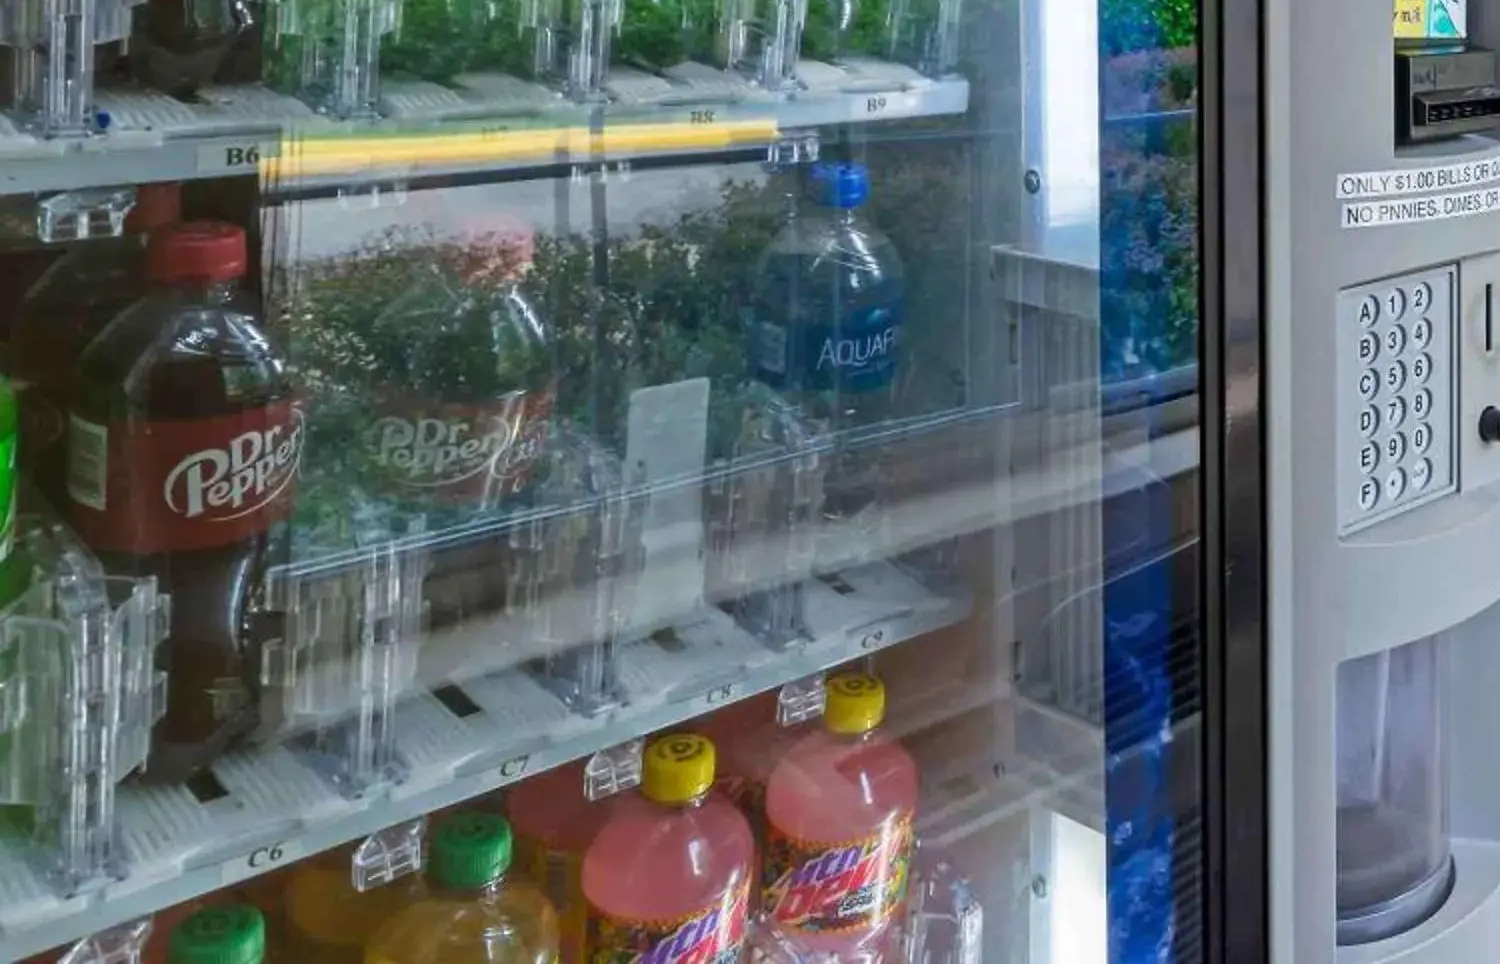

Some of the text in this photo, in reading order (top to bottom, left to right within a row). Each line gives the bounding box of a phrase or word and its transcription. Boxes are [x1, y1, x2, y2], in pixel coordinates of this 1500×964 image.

[866, 97, 888, 115] B9
[226, 146, 260, 168] B6
[1341, 175, 1391, 195] ONLY
[1395, 171, 1435, 191] $1.00
[1437, 166, 1471, 187] BILLS
[1473, 163, 1489, 182] OR
[1347, 207, 1373, 224] NO
[1359, 289, 1422, 322] A 1 2
[1359, 325, 1422, 358] B 3 4
[1359, 361, 1423, 395] C 5 6
[1360, 396, 1422, 431] D 7 8
[416, 417, 470, 448] Dr
[229, 425, 282, 473] Dr
[1361, 430, 1423, 467] E 9 0
[164, 426, 301, 518] Pepper
[1361, 484, 1370, 503] F
[707, 683, 734, 704] C8
[501, 755, 530, 778] C7
[247, 840, 285, 869] C6
